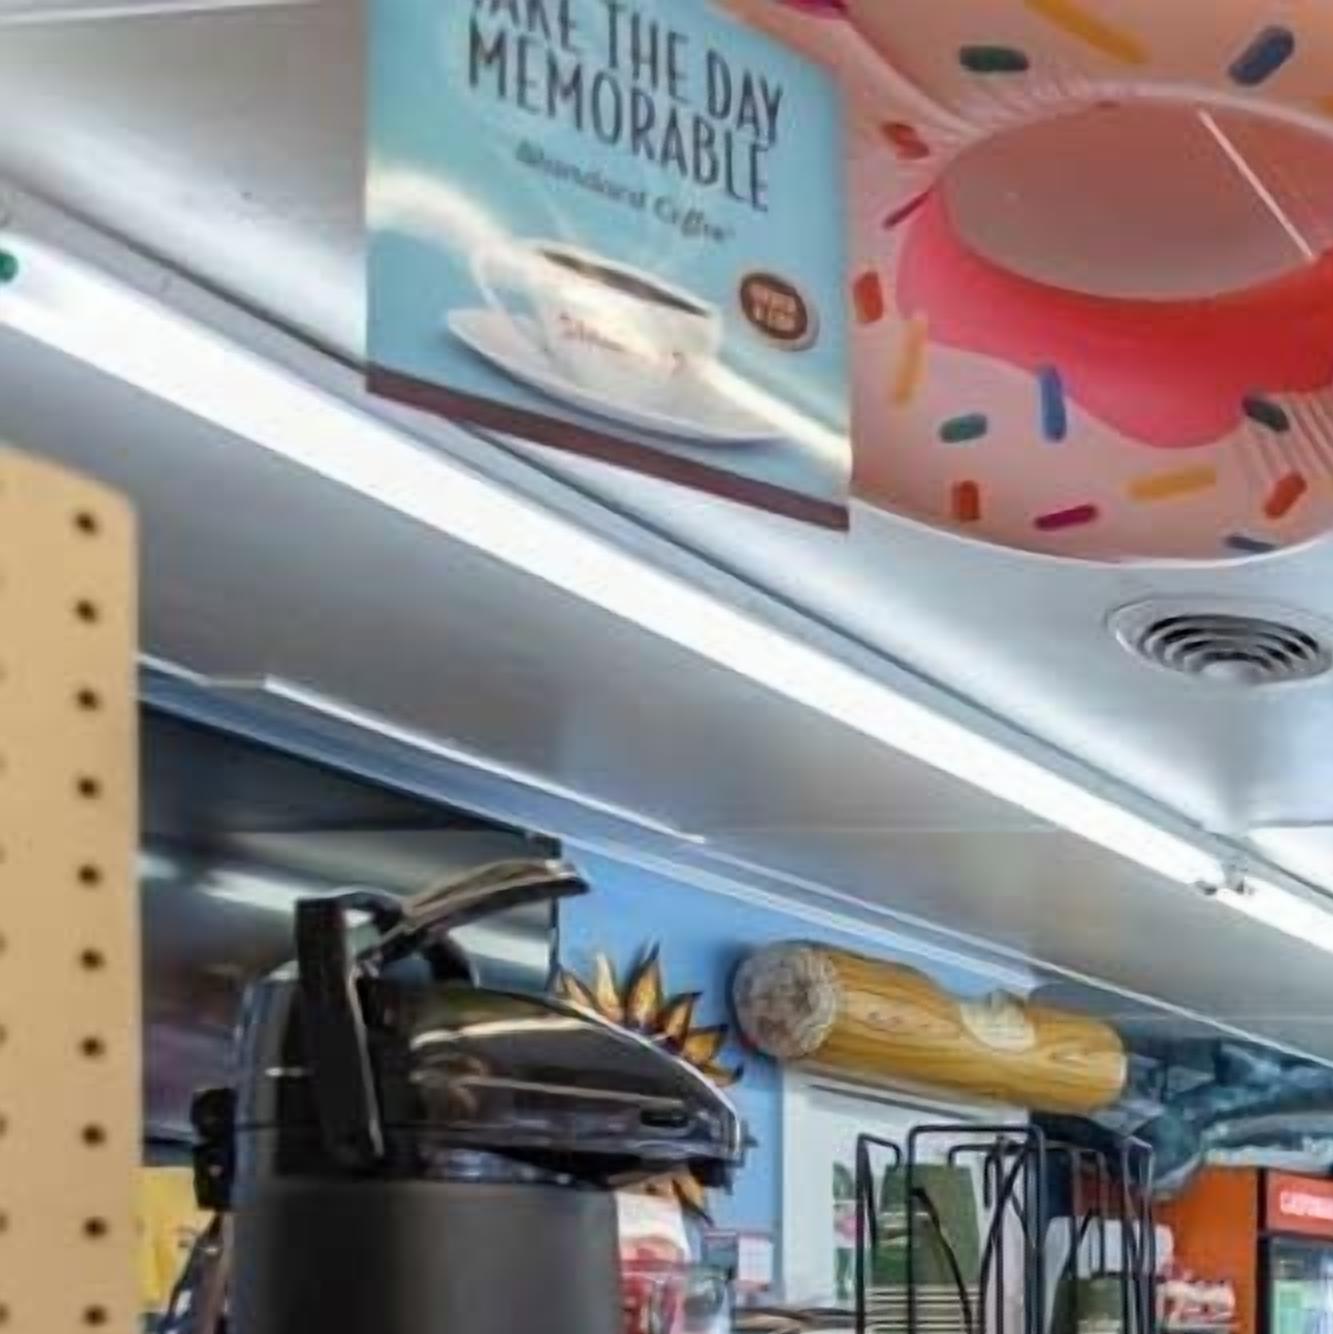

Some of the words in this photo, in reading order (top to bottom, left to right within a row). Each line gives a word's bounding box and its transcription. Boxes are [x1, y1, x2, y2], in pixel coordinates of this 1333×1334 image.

[469, 15, 769, 213] MEMORABLE
[604, 2, 690, 104] THE
[705, 48, 784, 148] DAY
